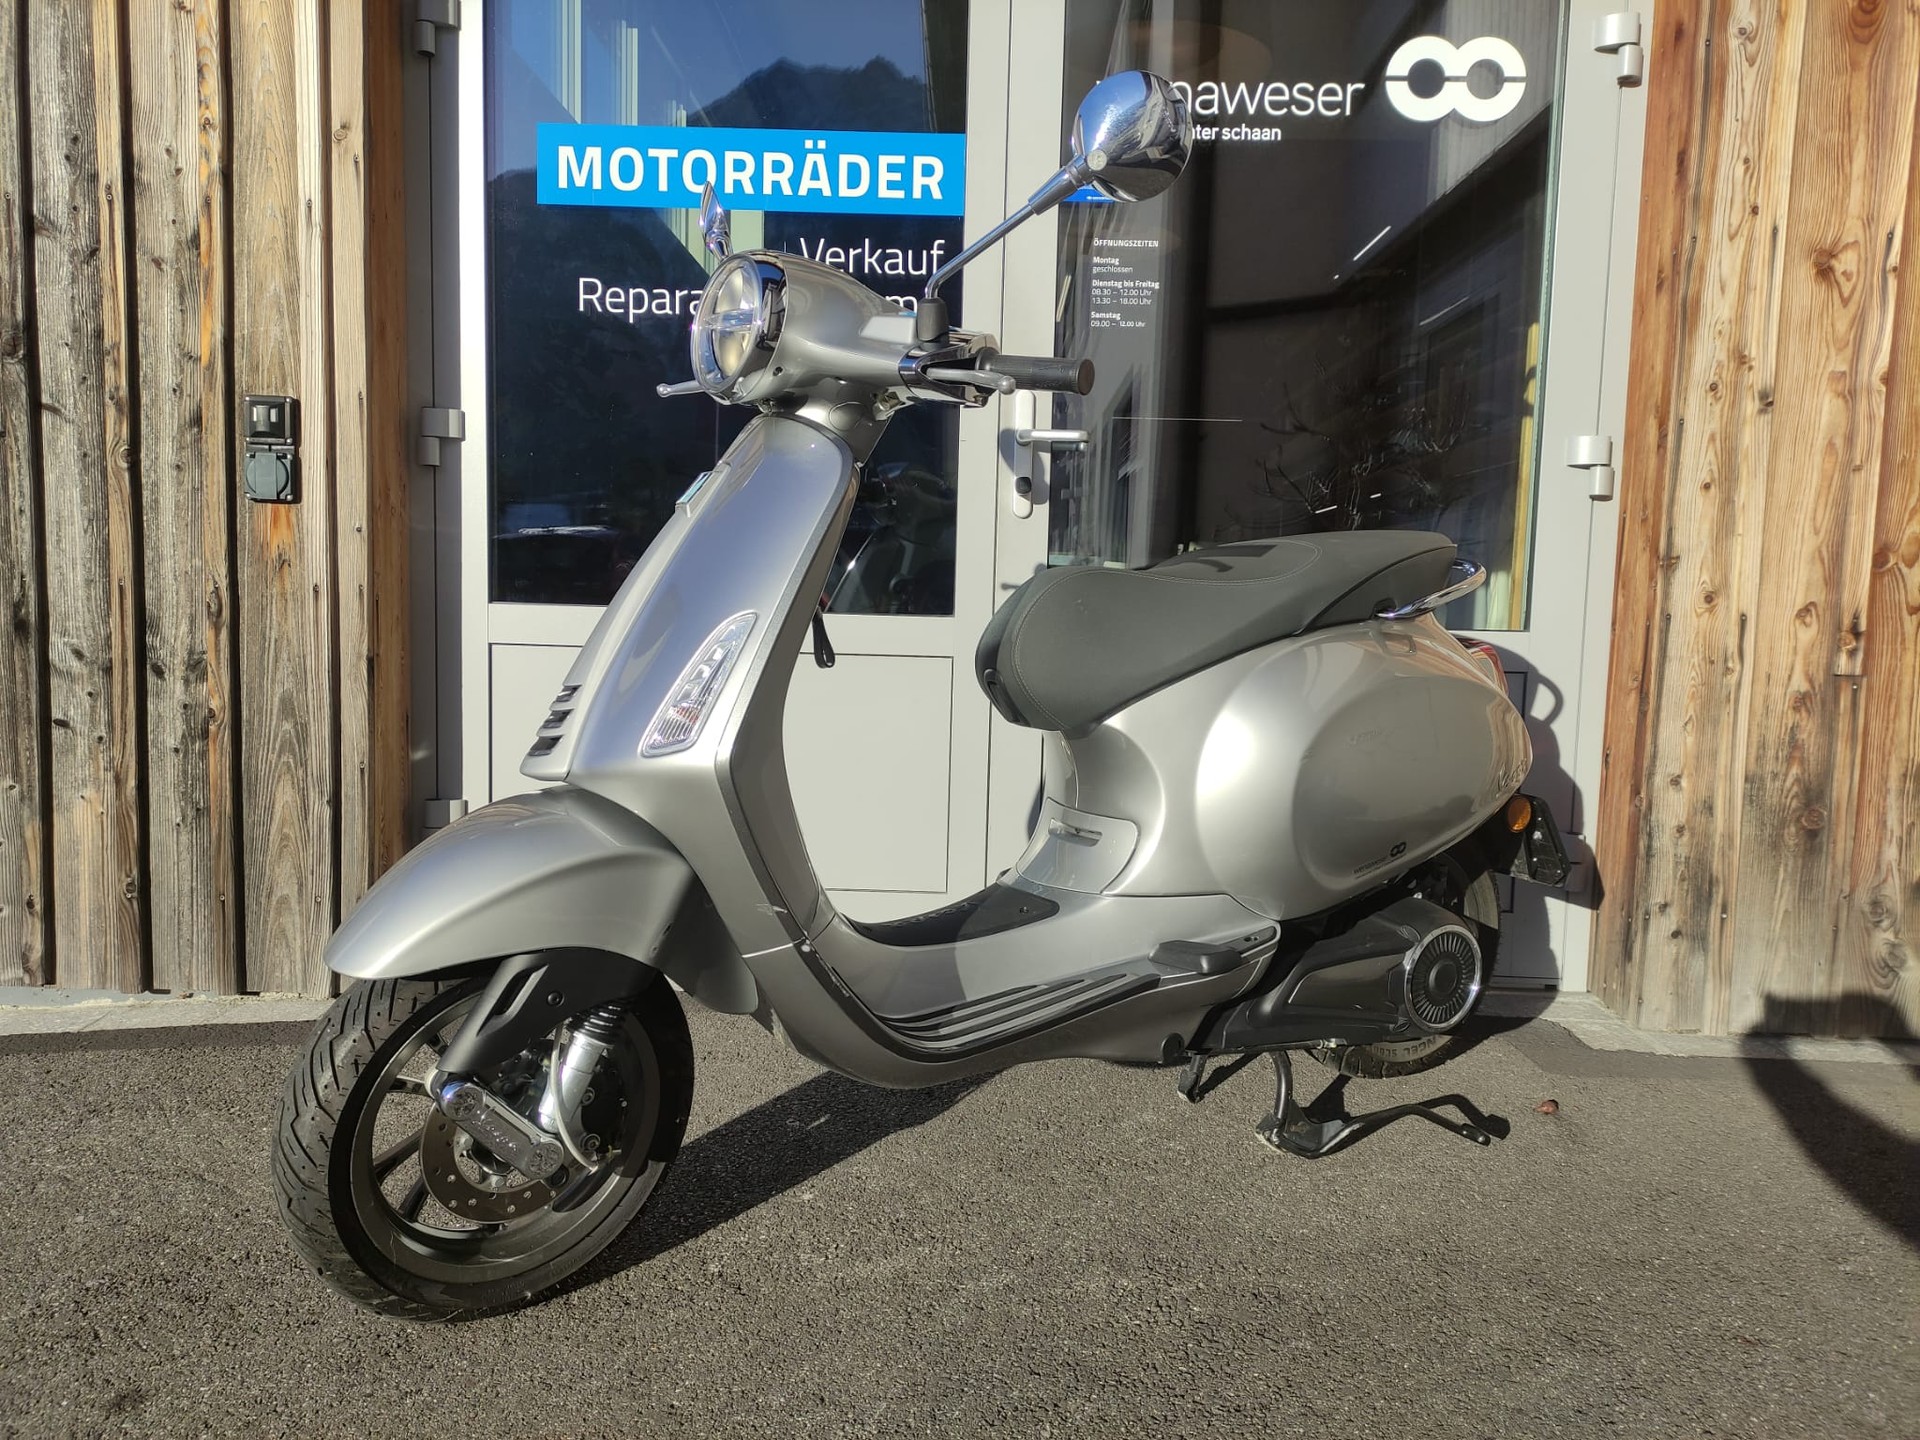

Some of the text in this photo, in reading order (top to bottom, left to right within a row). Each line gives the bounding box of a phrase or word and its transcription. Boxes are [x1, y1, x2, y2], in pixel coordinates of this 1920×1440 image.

[1222, 123, 1282, 141] schaan
[557, 140, 944, 200] MOTORRÄDER
[1093, 238, 1159, 247] ÖFFNUNGSZEITEN
[800, 237, 946, 276] Verkauf
[1093, 257, 1119, 265] Montag
[1092, 265, 1133, 274] geschlossen
[1092, 280, 1122, 288] Dienstag
[1135, 281, 1160, 289] Freitag
[1091, 312, 1121, 320] Samstag
